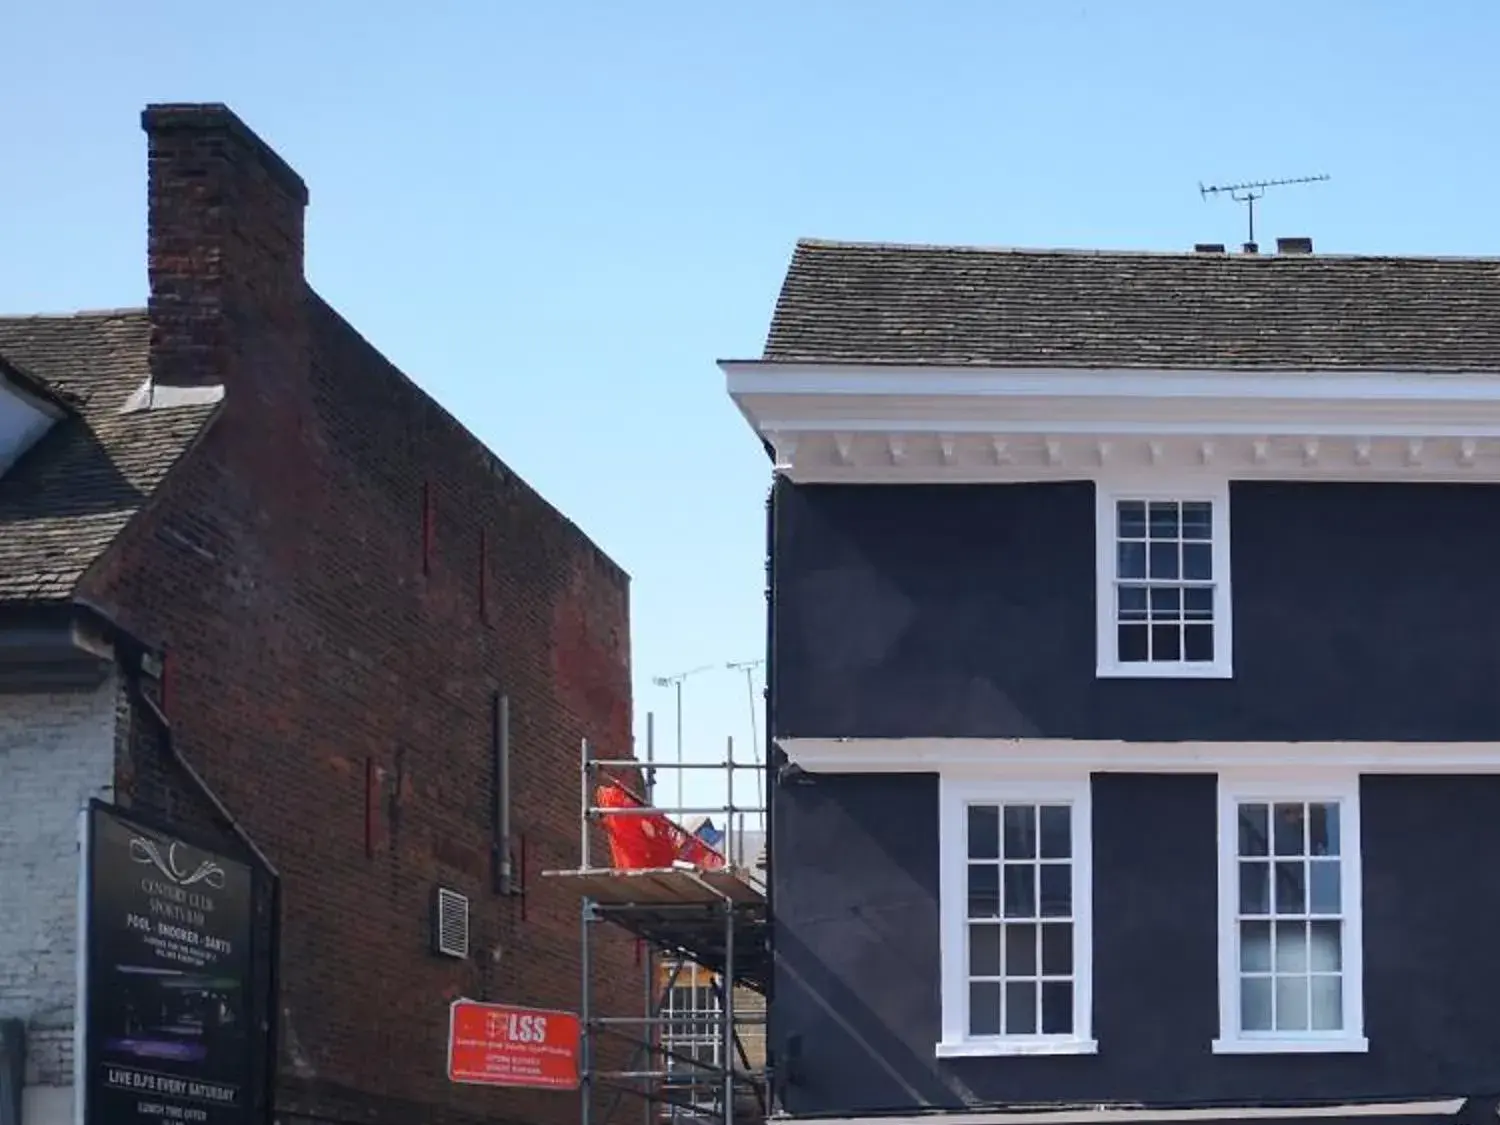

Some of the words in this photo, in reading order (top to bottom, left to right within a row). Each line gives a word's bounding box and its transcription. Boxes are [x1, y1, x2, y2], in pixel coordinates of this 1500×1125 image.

[126, 913, 151, 932] POOL
[157, 922, 198, 944] SNOOKER
[508, 1013, 547, 1043] LSS
[109, 1069, 132, 1085] LIVE
[157, 1077, 187, 1094] EVERY
[188, 1082, 235, 1101] SATURDAY
